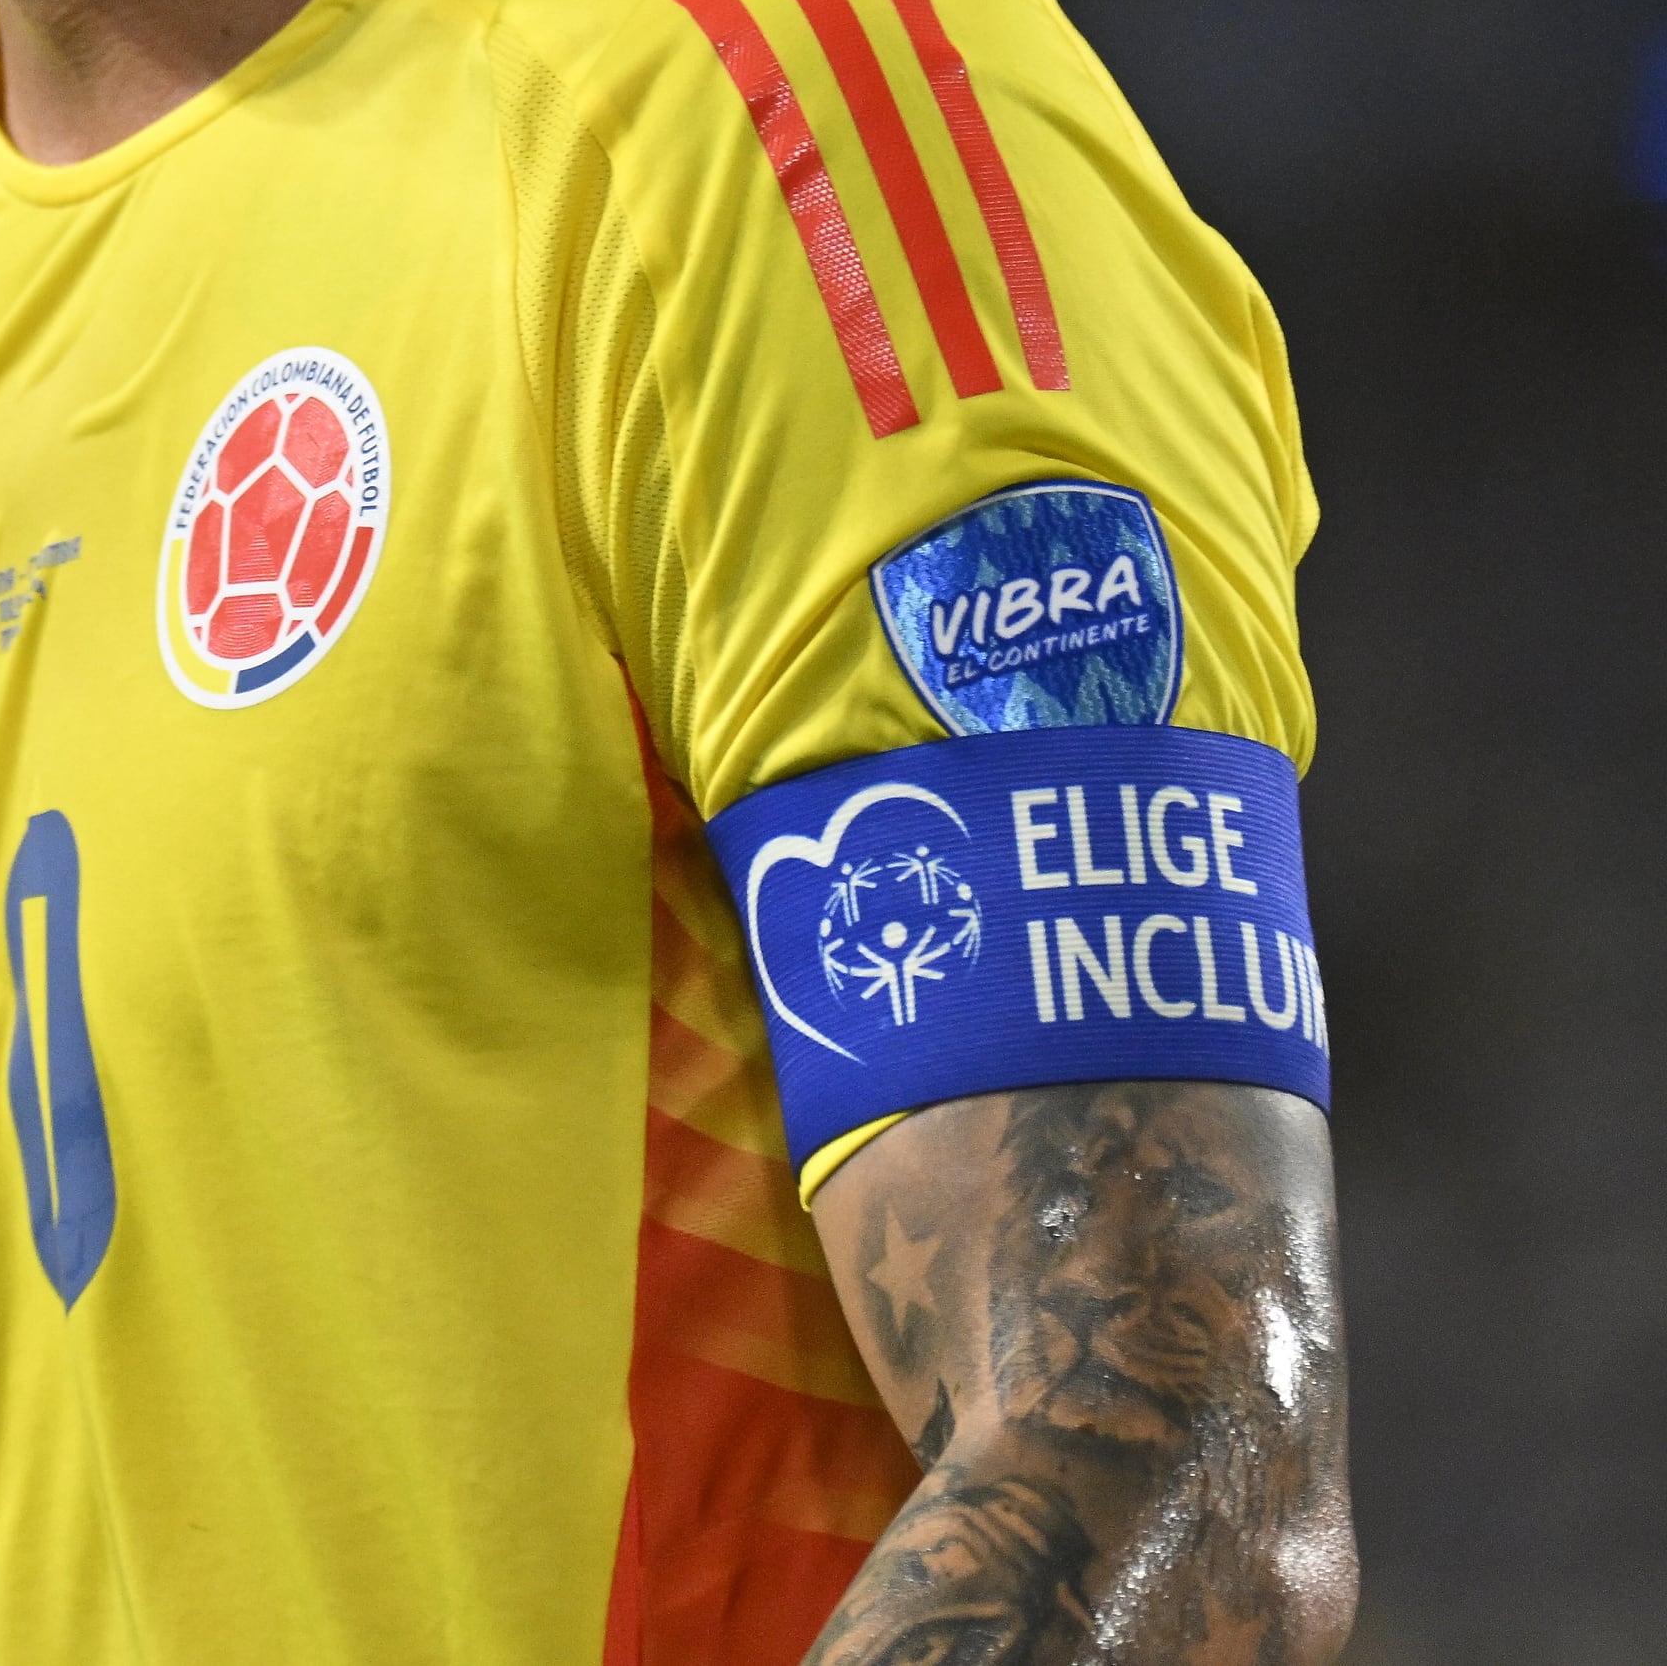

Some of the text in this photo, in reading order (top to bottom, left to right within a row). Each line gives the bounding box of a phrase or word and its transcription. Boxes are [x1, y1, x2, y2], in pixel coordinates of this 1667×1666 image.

[252, 360, 354, 403] COLOMBIANA
[347, 394, 371, 426] DE
[932, 555, 1142, 655] VIBRA
[947, 614, 1151, 685] EL CONTINENTE
[1010, 785, 1259, 896] ELIGE
